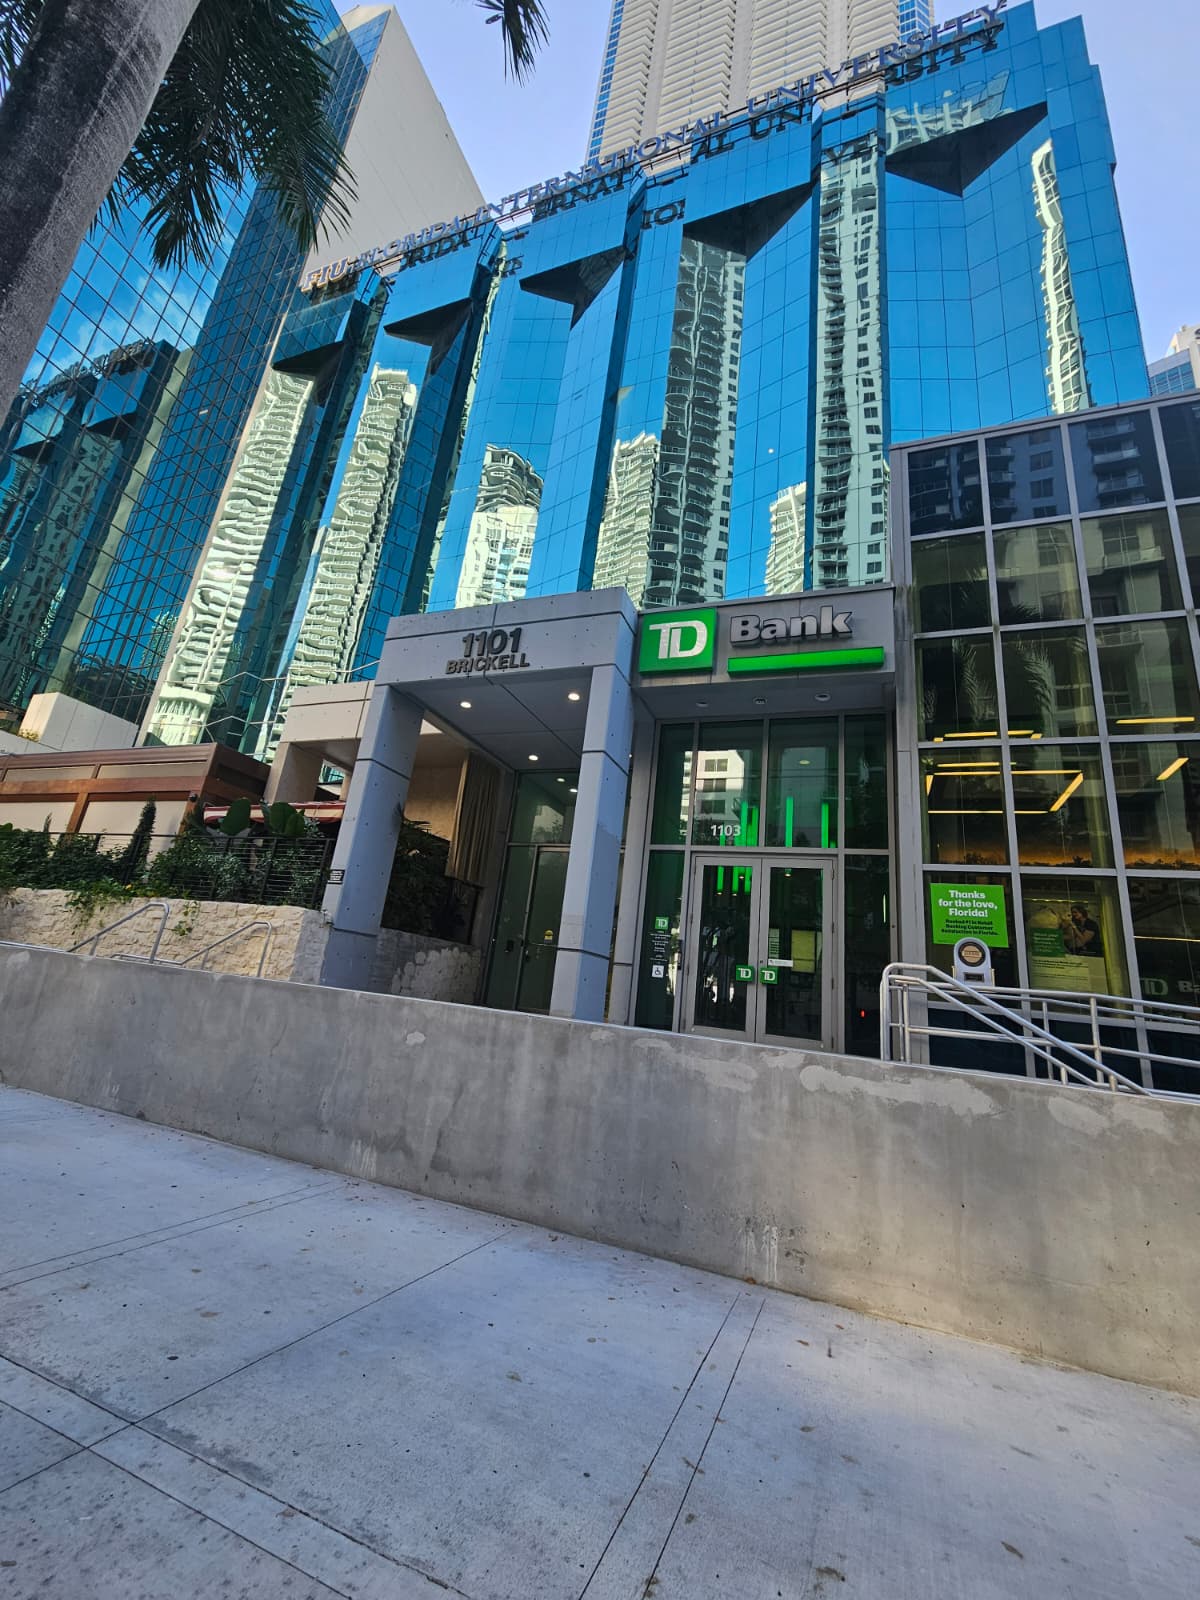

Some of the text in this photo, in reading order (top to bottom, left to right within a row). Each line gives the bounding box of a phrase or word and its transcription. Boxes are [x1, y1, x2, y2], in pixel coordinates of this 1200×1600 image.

[300, 256, 352, 293] FIU
[475, 110, 729, 224] INTERNATIONAL
[747, 2, 1007, 118] UNIVERSITY
[649, 605, 853, 660] TD Bank
[462, 627, 523, 658] 1101
[445, 653, 531, 675] BRICKELL
[710, 824, 741, 837] 1103
[948, 889, 986, 899] Thanks
[938, 898, 998, 910] for the love,
[948, 908, 988, 918] Florida!
[738, 967, 752, 979] TD
[762, 970, 776, 981] TD
